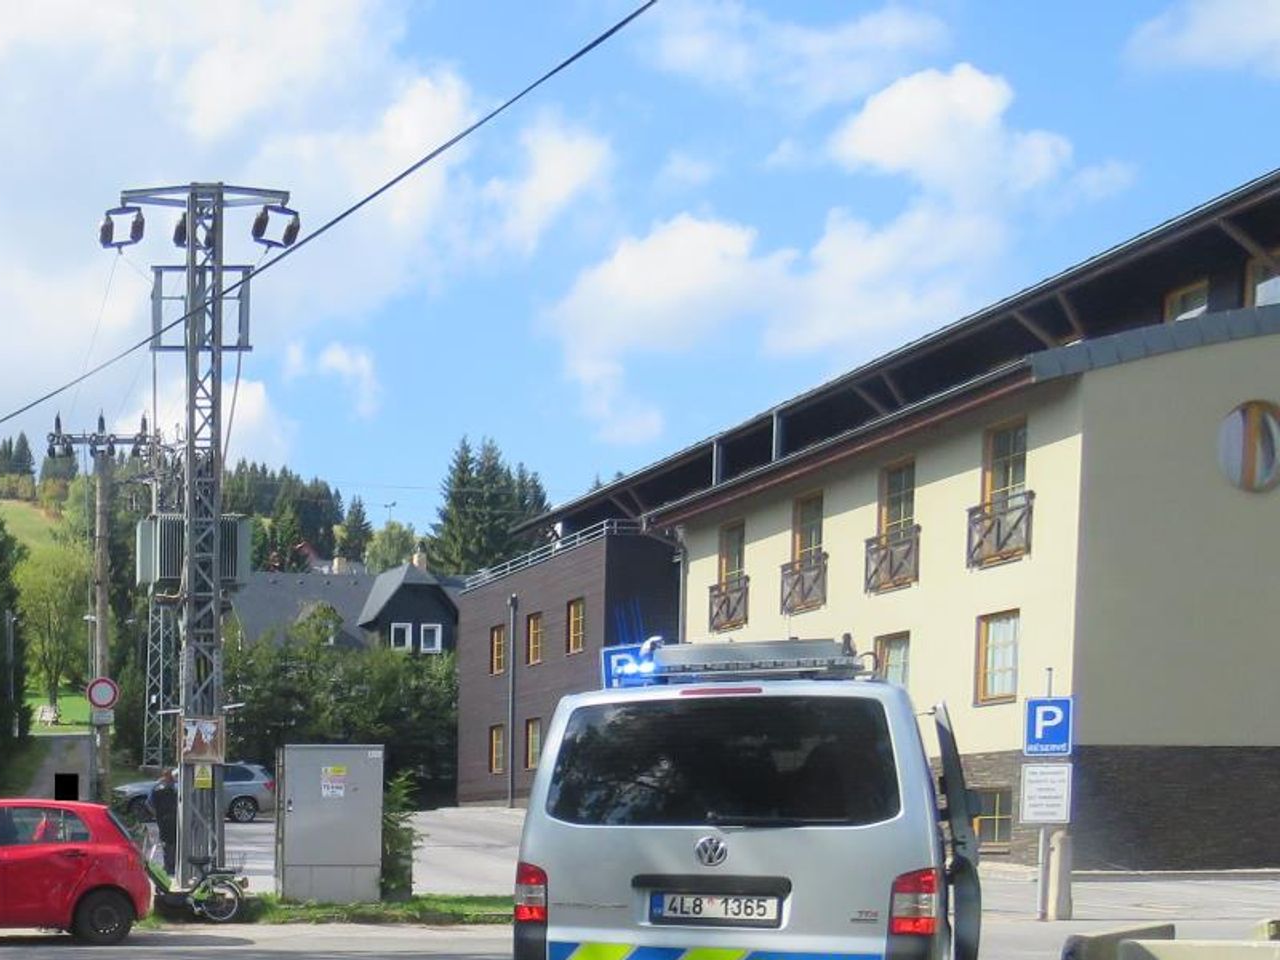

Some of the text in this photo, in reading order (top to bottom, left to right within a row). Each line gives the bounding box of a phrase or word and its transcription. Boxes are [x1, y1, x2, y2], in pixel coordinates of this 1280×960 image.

[1035, 705, 1064, 739] P
[667, 896, 767, 917] 4L8 1365
